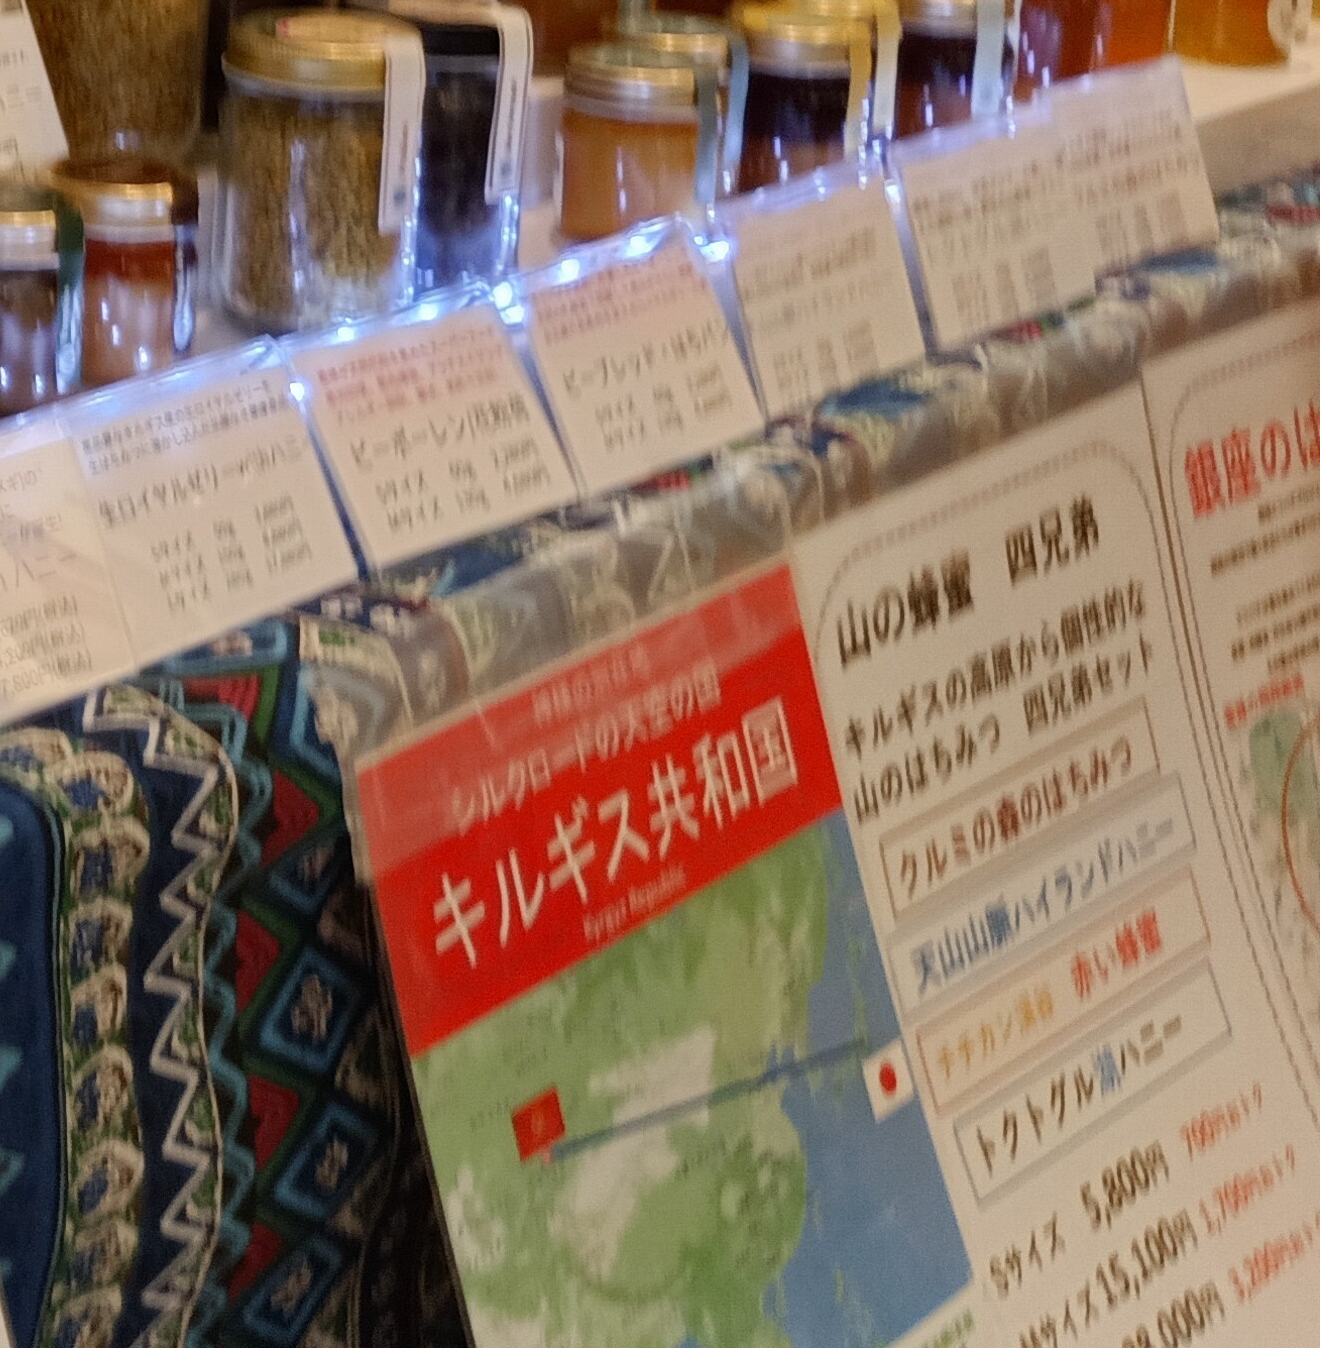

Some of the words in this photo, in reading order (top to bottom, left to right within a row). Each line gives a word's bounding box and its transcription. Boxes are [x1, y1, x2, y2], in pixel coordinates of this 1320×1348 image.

[13, 552, 77, 589] ハニー
[1004, 492, 1101, 589] 四兄弟
[843, 577, 1147, 758] キルギスの高原から個性的な
[854, 713, 1001, 825] 山のはちみつ
[1022, 631, 1153, 738] 四兄弟セット
[433, 694, 799, 969] キルギス共和国
[899, 734, 1133, 896] クルミの森のはちみつ
[1079, 1138, 1171, 1232] 5,800円
[1096, 1206, 1199, 1311] 15,100円
